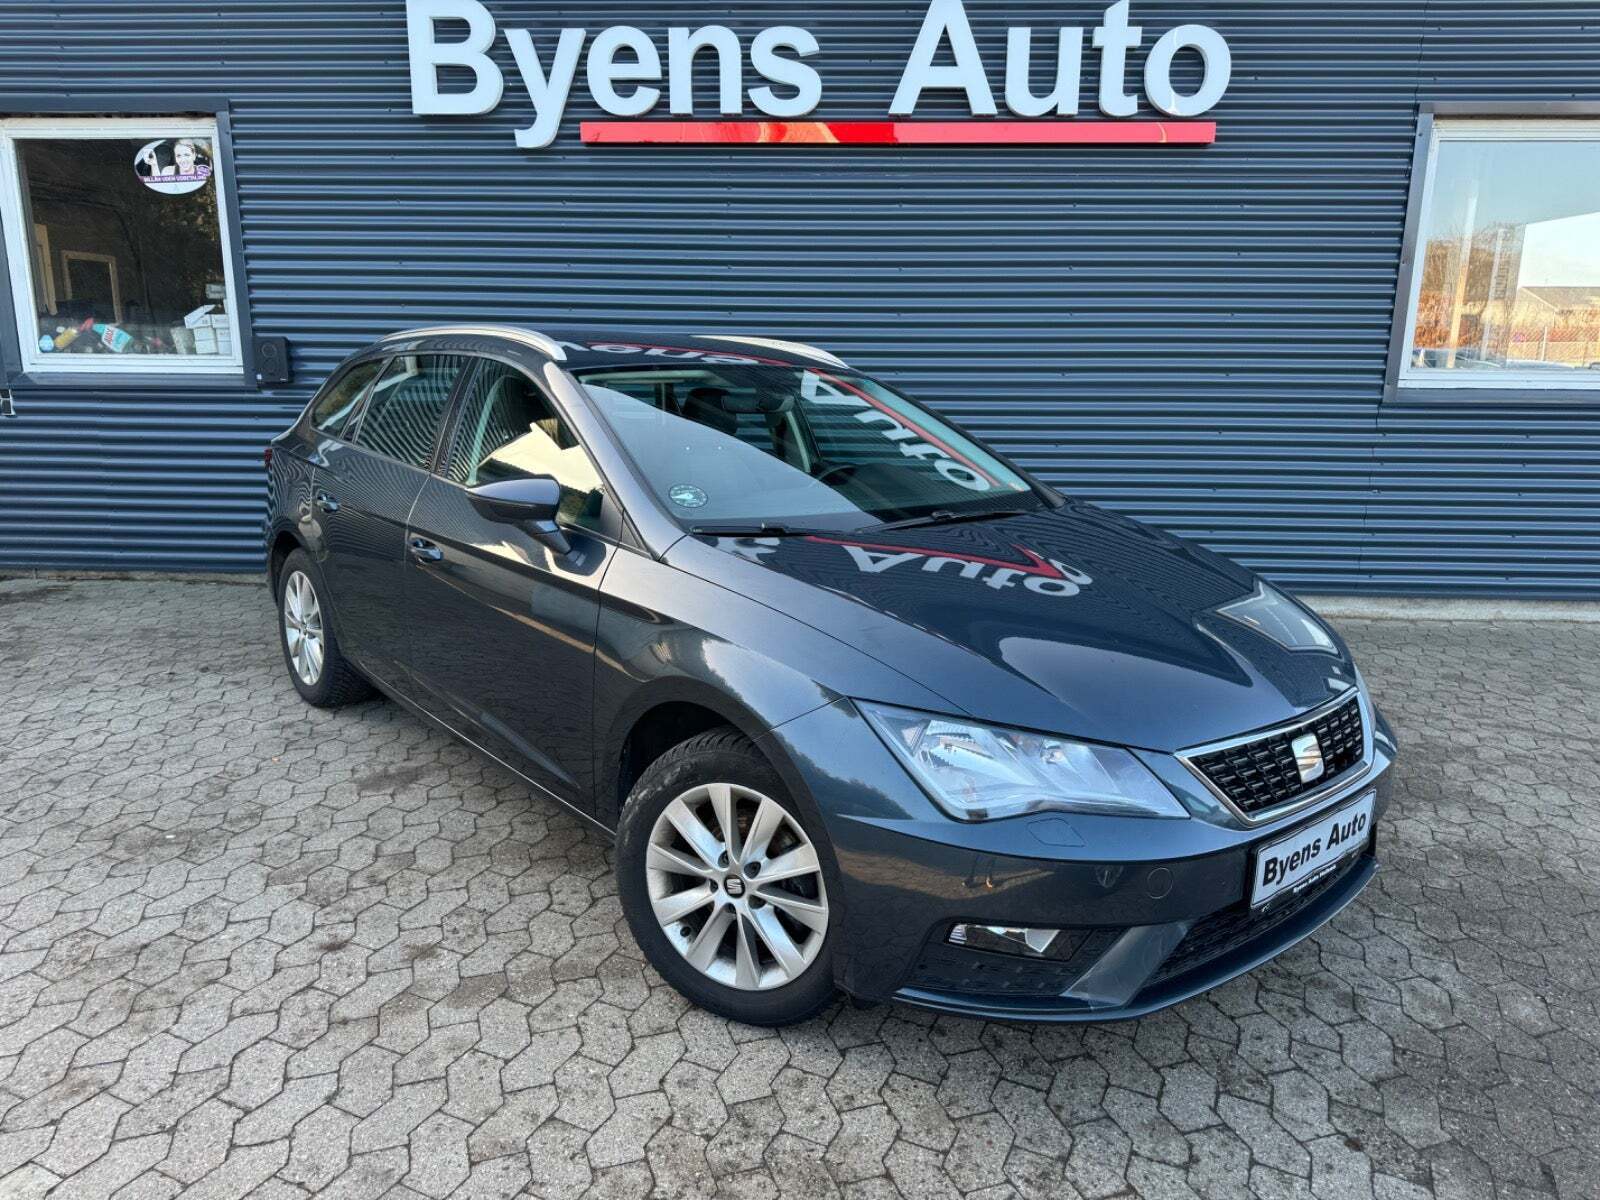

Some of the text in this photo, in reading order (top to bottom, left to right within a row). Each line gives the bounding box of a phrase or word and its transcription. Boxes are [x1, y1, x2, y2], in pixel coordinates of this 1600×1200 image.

[406, 0, 1231, 148] Byens Auto
[1262, 837, 1321, 887] Byens
[1326, 812, 1367, 850] Auto
